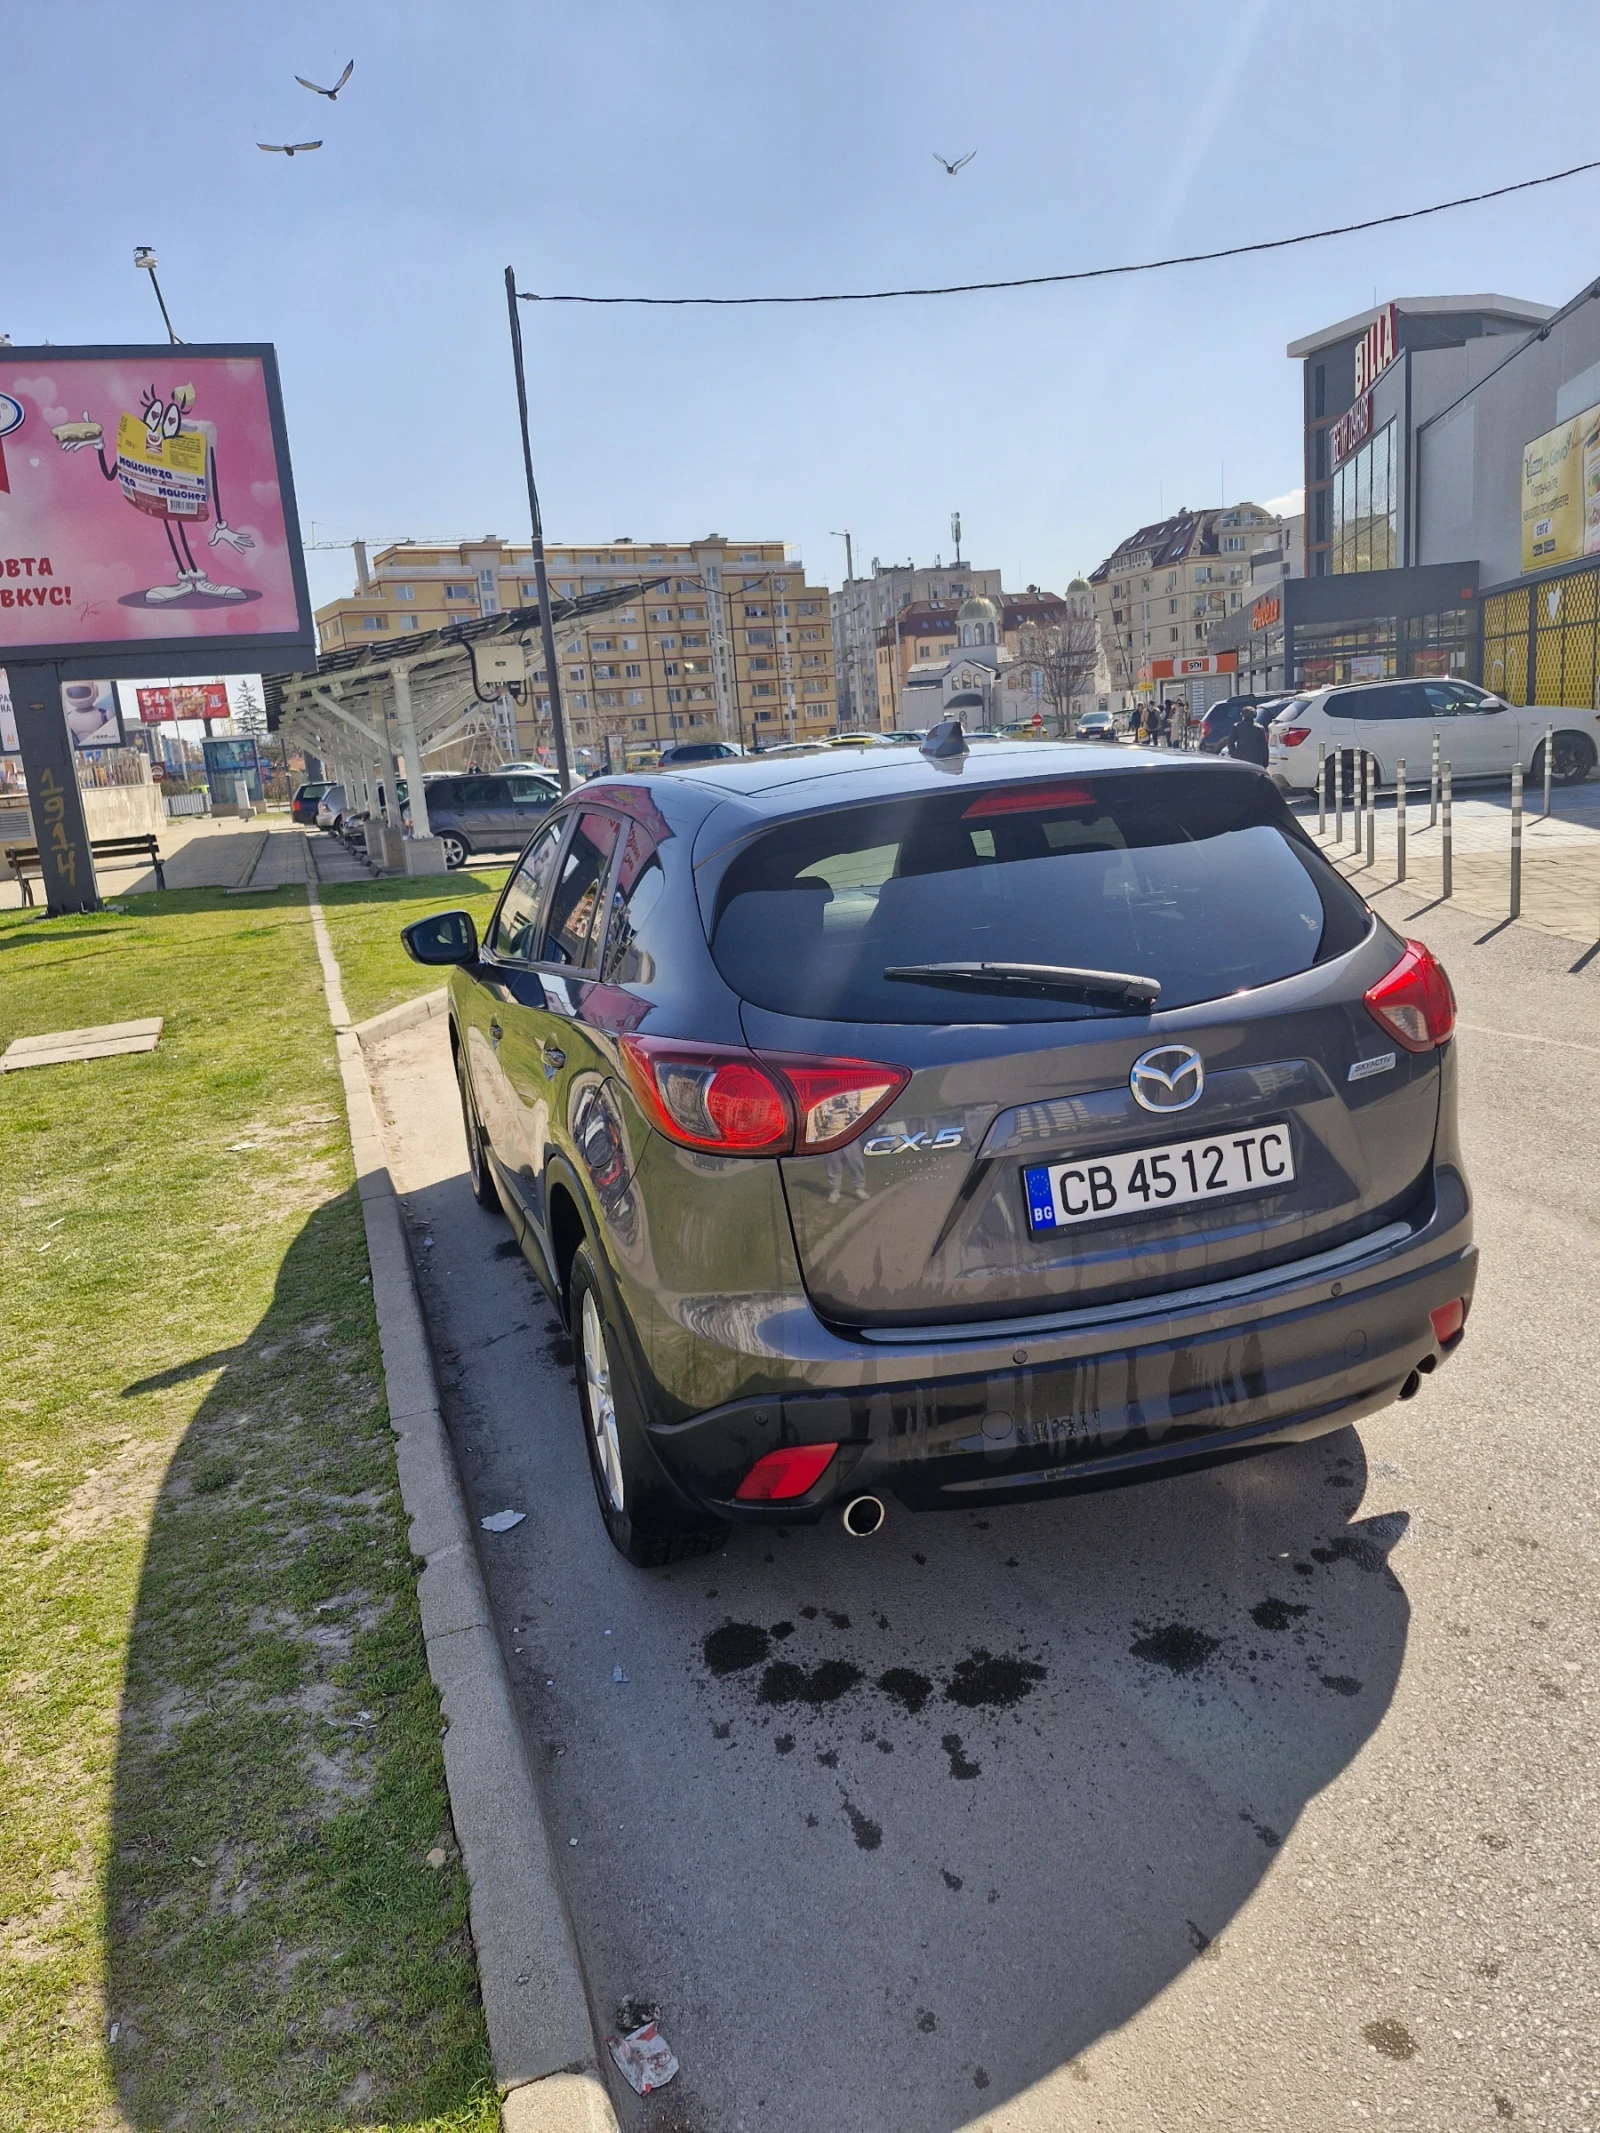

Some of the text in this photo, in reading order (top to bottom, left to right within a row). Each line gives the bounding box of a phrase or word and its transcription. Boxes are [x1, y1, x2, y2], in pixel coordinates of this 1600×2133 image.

[1355, 303, 1396, 399] BILLA
[0, 586, 71, 608] ВКУС!
[1355, 1056, 1393, 1072] SKYACTIV
[863, 1126, 965, 1156] CX-5
[1059, 1134, 1286, 1216] CB 4512 TC
[1034, 1206, 1053, 1222] BG
